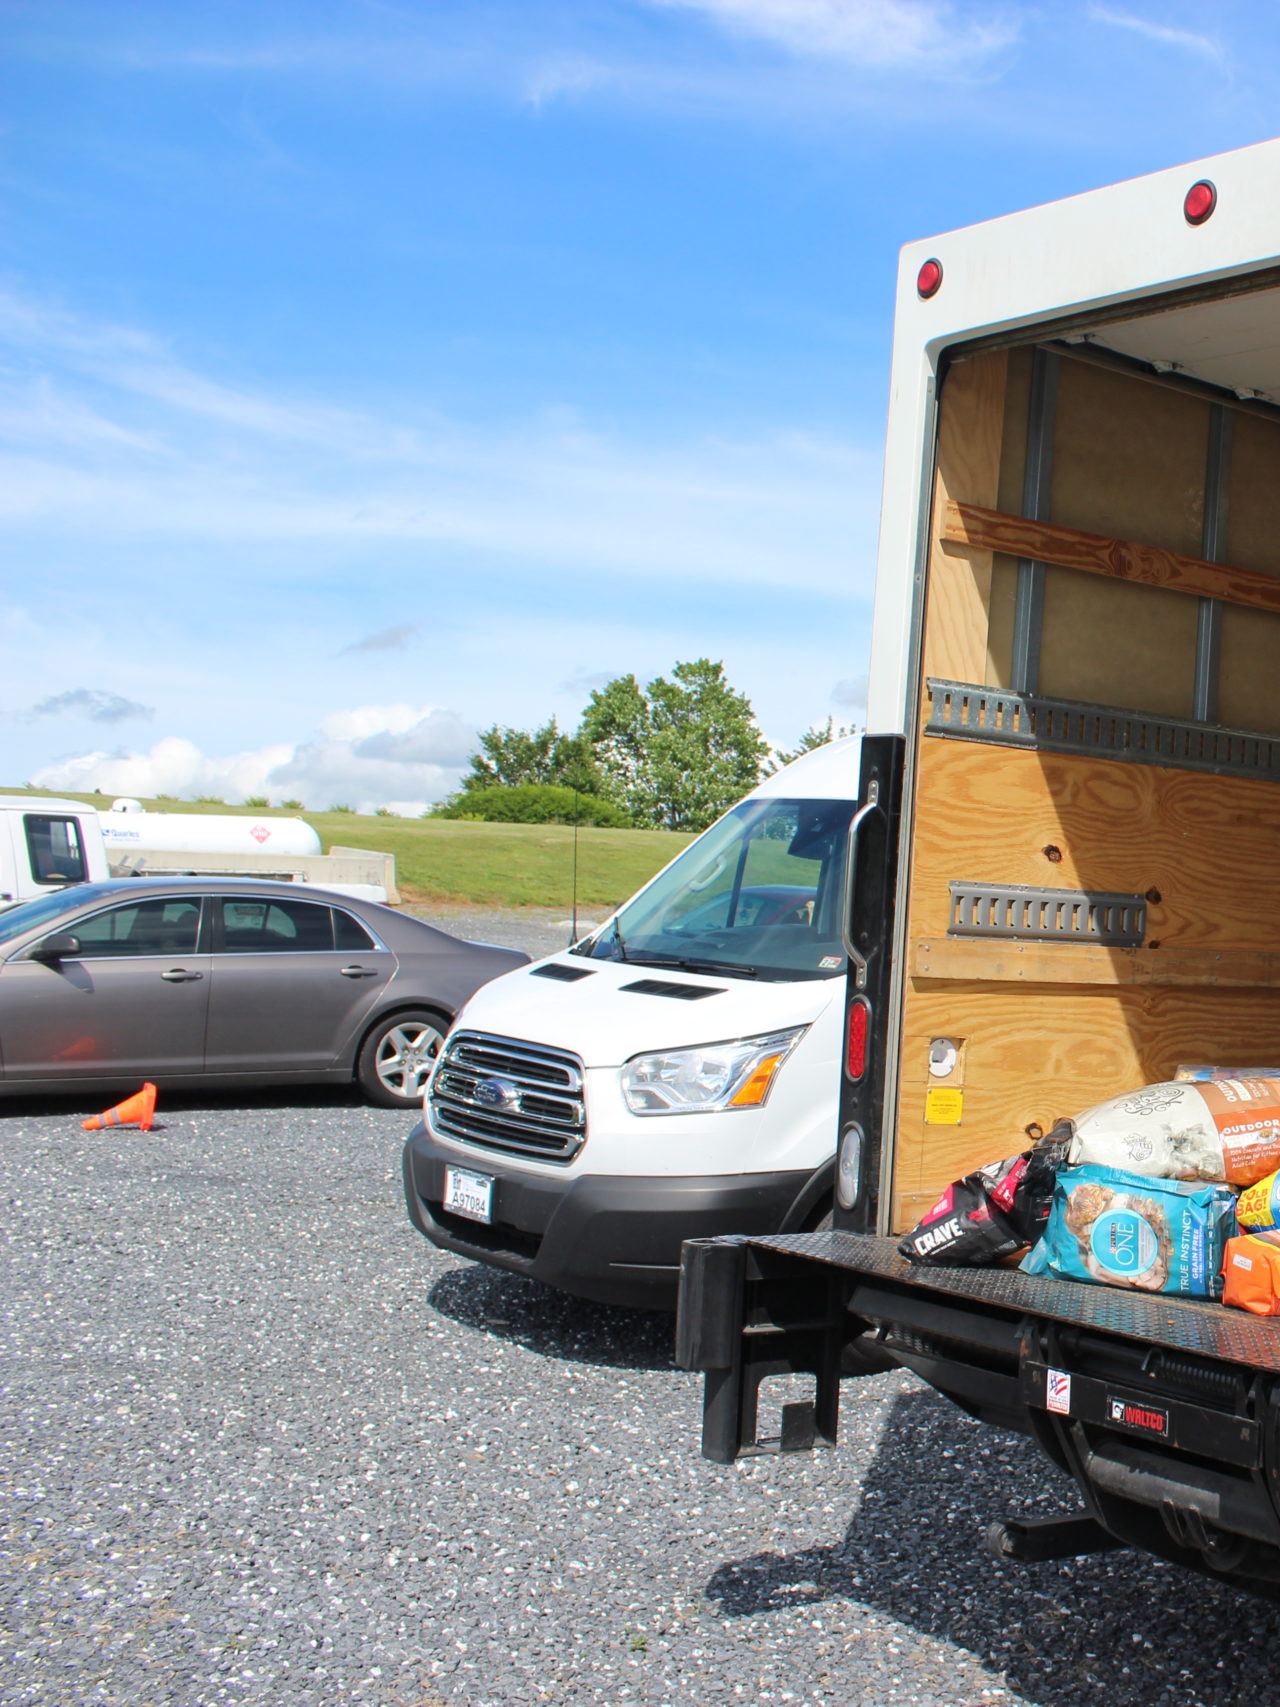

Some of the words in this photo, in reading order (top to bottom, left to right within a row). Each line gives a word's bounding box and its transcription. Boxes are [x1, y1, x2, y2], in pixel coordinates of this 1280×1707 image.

[1223, 1119, 1280, 1135] OUTDOOR
[452, 1191, 486, 1213] A97084
[1236, 1198, 1267, 1217] BAG!
[913, 1217, 964, 1257] CRAVE
[1115, 1223, 1135, 1266] ONE
[1181, 1210, 1192, 1262] INSTINCT
[1180, 1264, 1189, 1292] TRUE
[1191, 1252, 1199, 1280] GRAIN
[1125, 1406, 1164, 1431] WALTCO
